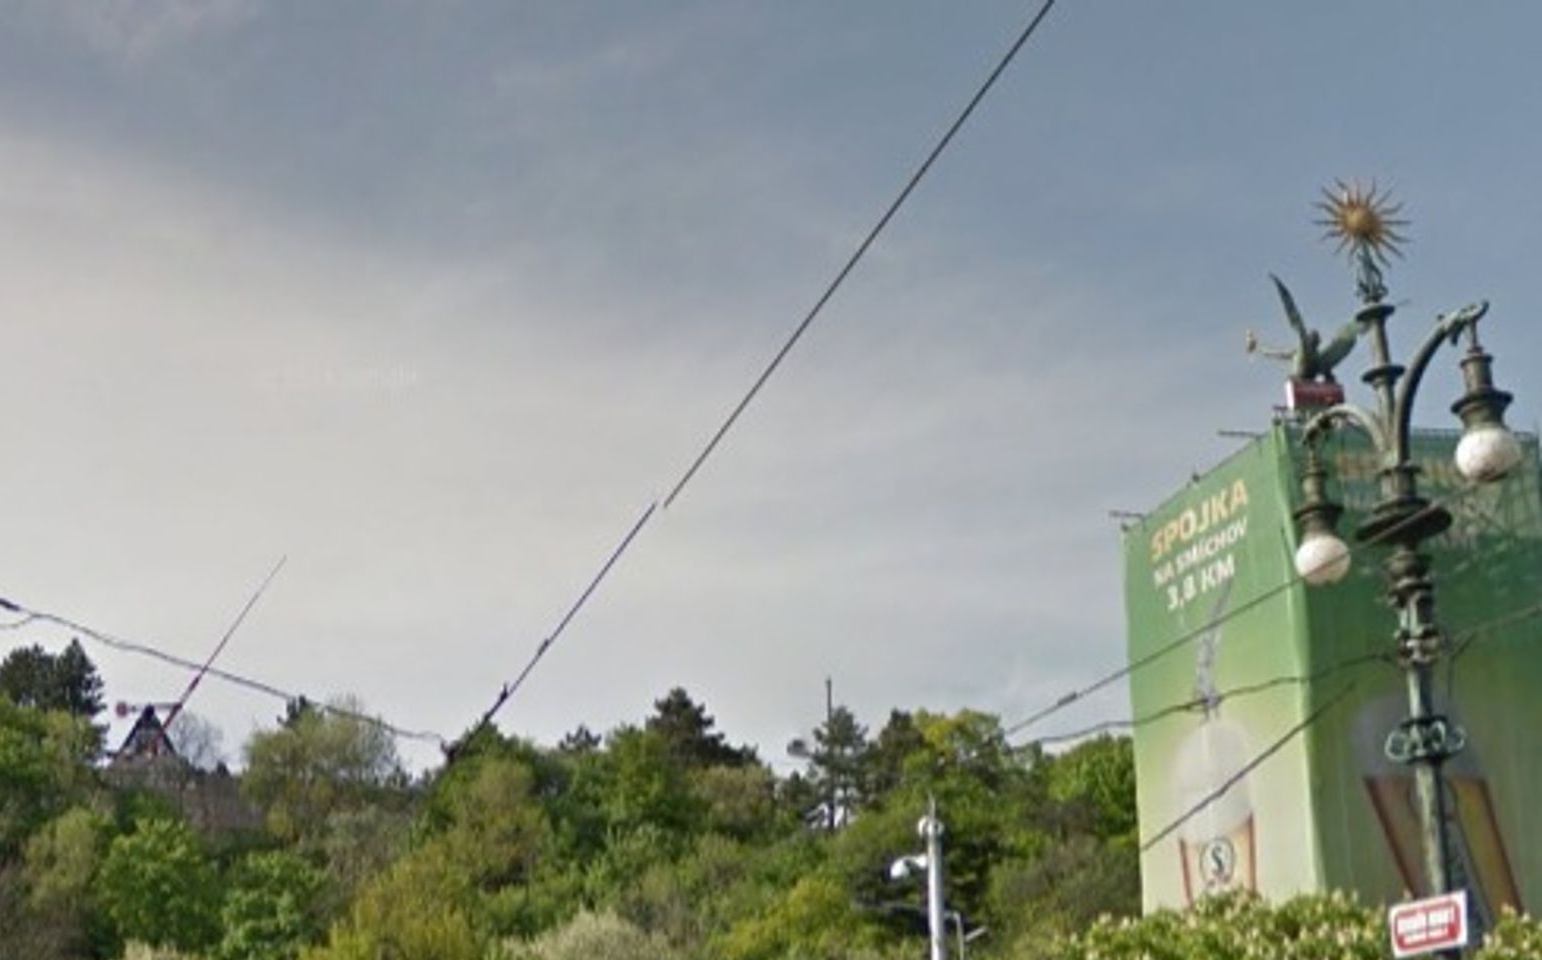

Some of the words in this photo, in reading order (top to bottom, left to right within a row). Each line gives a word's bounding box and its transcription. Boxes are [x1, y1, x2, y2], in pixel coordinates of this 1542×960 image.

[1149, 478, 1248, 564] SPOJKA
[1154, 560, 1175, 586] NA
[1166, 573, 1196, 611] 3,8
[1200, 552, 1235, 593] KM
